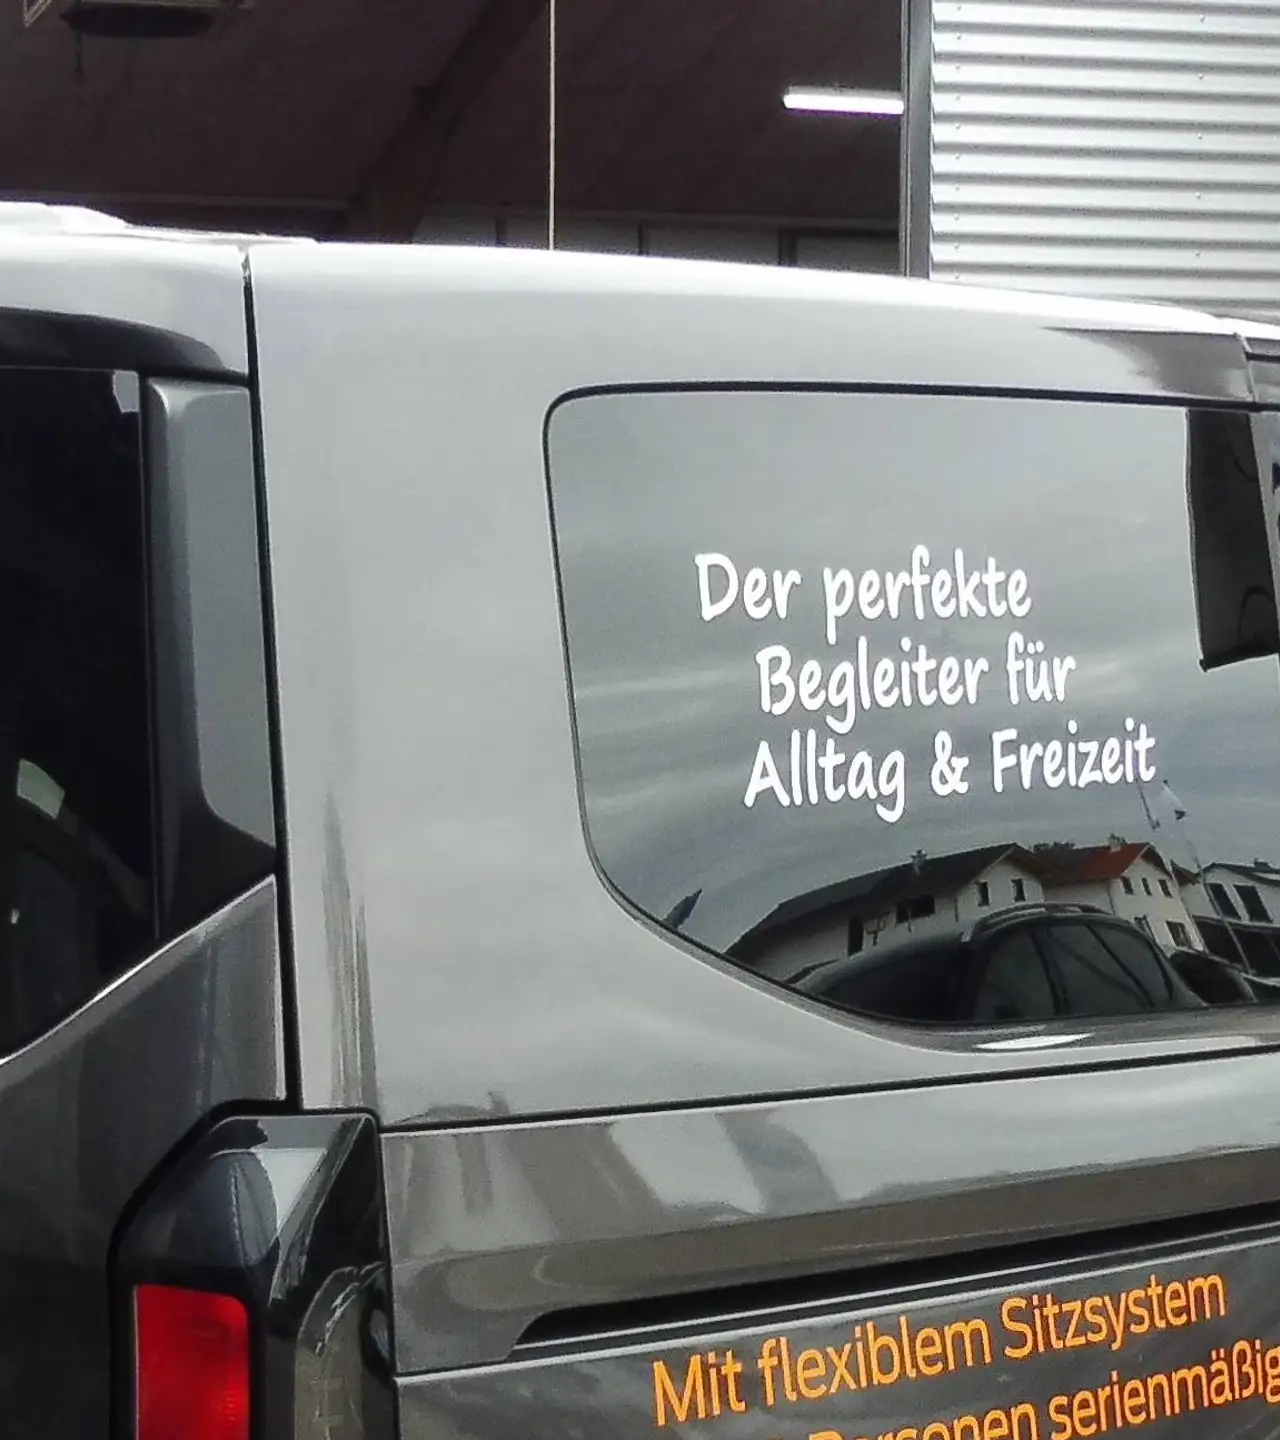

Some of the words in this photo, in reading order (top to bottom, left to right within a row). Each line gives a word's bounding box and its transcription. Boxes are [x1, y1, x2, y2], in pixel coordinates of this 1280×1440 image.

[694, 552, 801, 622] Der
[822, 544, 1032, 646] perfekte
[755, 635, 989, 734] Begleiter
[1005, 630, 1077, 705] für
[743, 727, 906, 824] Alltag
[930, 729, 971, 797] &
[990, 716, 1157, 793] Freizeit
[651, 1345, 747, 1427] Mit
[758, 1315, 991, 1406] flexiblem
[1000, 1272, 1226, 1359] Sitzsystem
